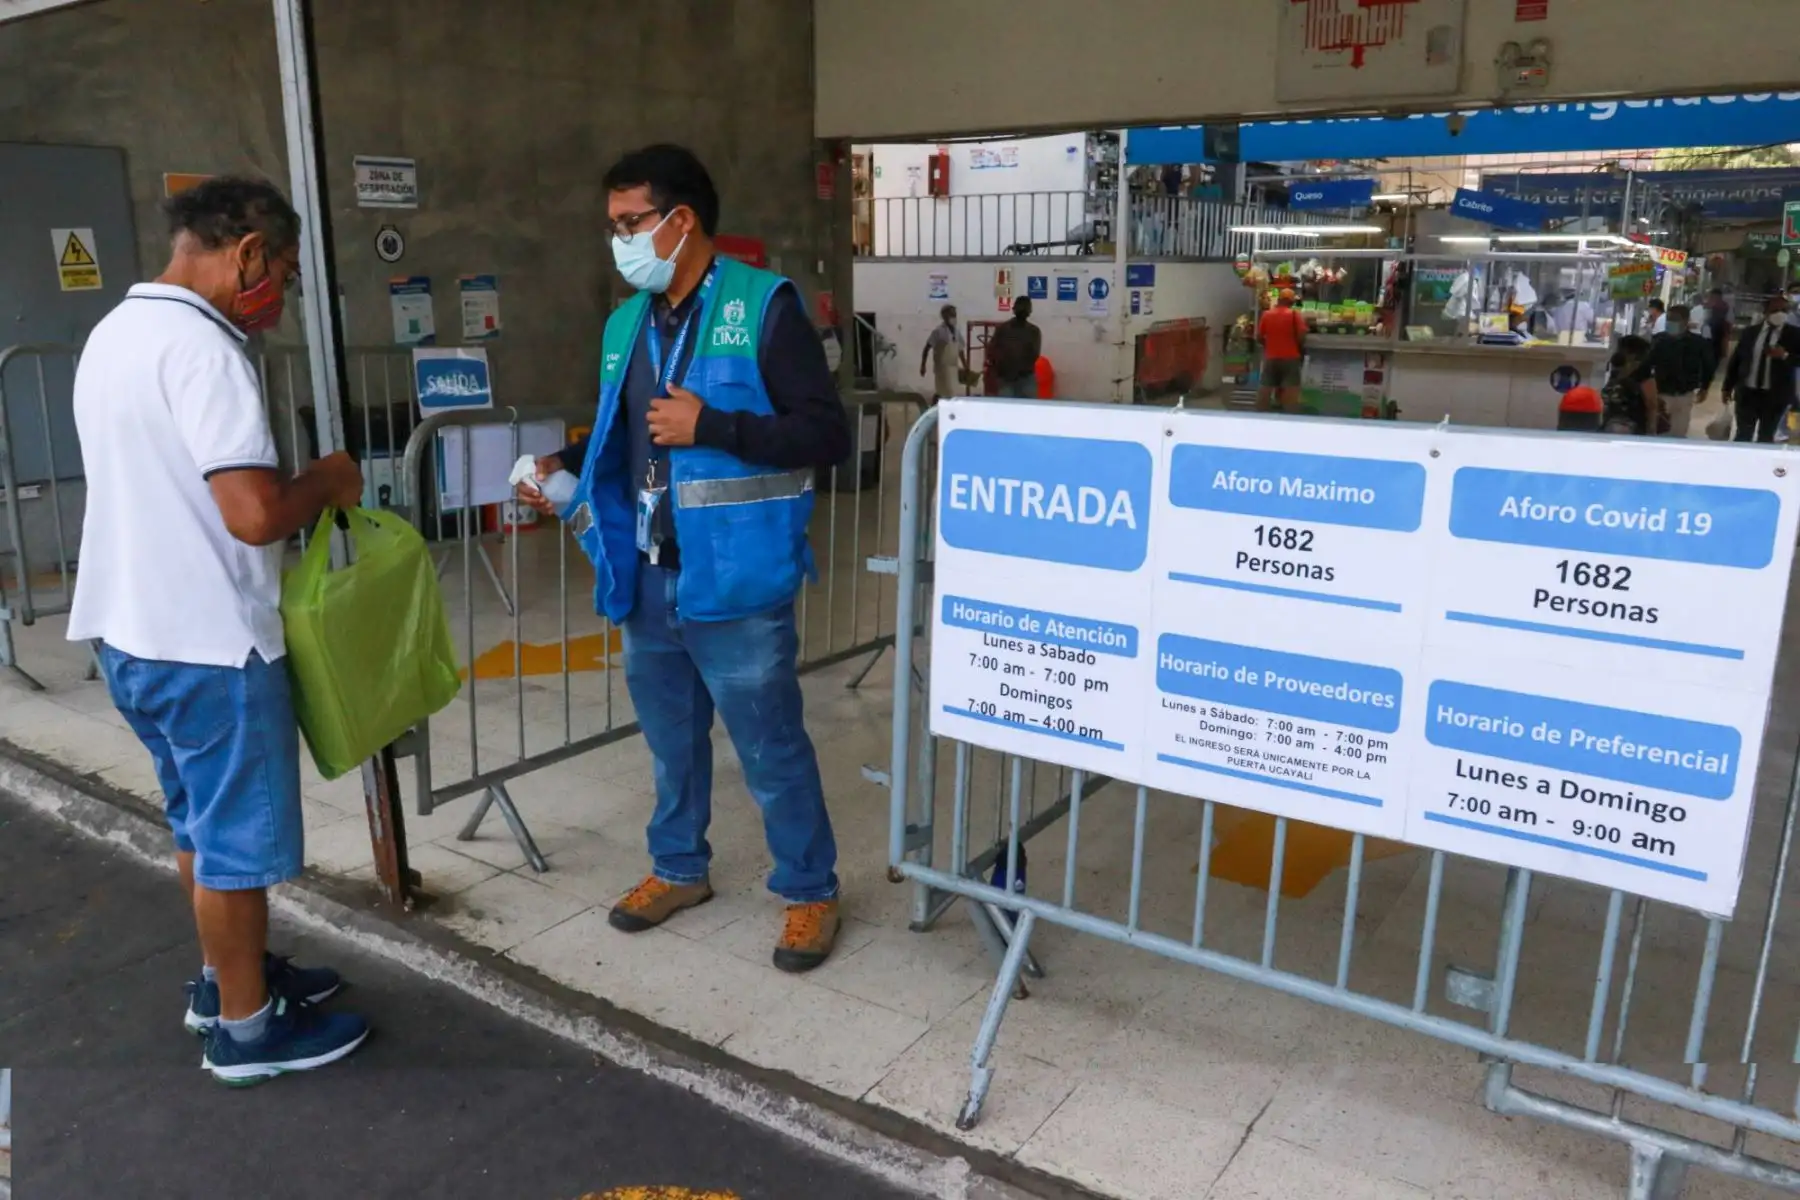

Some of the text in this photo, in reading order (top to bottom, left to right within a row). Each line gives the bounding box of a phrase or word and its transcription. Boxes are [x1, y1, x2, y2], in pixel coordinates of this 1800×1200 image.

[1295, 191, 1323, 201] Queso
[1459, 197, 1493, 213] Cabrito
[713, 332, 751, 346] LIMA
[425, 374, 480, 394] SALIDA
[949, 473, 1137, 529] ENTRADA
[1212, 471, 1375, 505] Aforo Maximo
[1500, 496, 1712, 536] Aforo Covid 19
[1254, 525, 1314, 552] 1682
[1236, 552, 1335, 581] Personas
[1556, 560, 1631, 591] 1682
[1534, 589, 1658, 624] Personas
[953, 603, 1127, 649] Horario de Atención
[983, 633, 1095, 666] Lunes a Sabado
[969, 654, 998, 672] 7:00
[1003, 664, 1026, 676] am
[1044, 668, 1076, 687] 7:00
[1084, 676, 1109, 692] pm
[1160, 652, 1395, 709] Horario de Proveedores
[999, 683, 1072, 711] Domingos
[968, 699, 996, 716] 7:00
[1003, 711, 1025, 725] am
[1043, 714, 1074, 733] 4:00
[1079, 726, 1103, 741] pm
[1162, 698, 1196, 715] Lunes
[1211, 704, 1258, 726] Sábado:
[1267, 718, 1294, 733] 7:00
[1297, 725, 1316, 736] am
[1336, 730, 1363, 746] 7:00
[1368, 738, 1388, 750] pm
[1175, 734, 1185, 744] EL
[1189, 737, 1230, 752] INGRESO
[1332, 760, 1353, 776] POR
[1356, 769, 1371, 781] LA
[1200, 720, 1257, 742] Domingo:
[1266, 731, 1293, 747] 7:00
[1295, 738, 1314, 750] am
[1334, 745, 1362, 760] 4:00
[1367, 752, 1387, 765] pm
[1437, 705, 1728, 775] Horario de Preferencial
[1227, 757, 1313, 781] PUERTA UCAYALI
[1456, 759, 1686, 824] Lunes a Domingo
[1448, 793, 1491, 815] 7:00
[1498, 805, 1537, 826] am
[1573, 819, 1620, 844] 9:00
[1632, 830, 1675, 857] am
